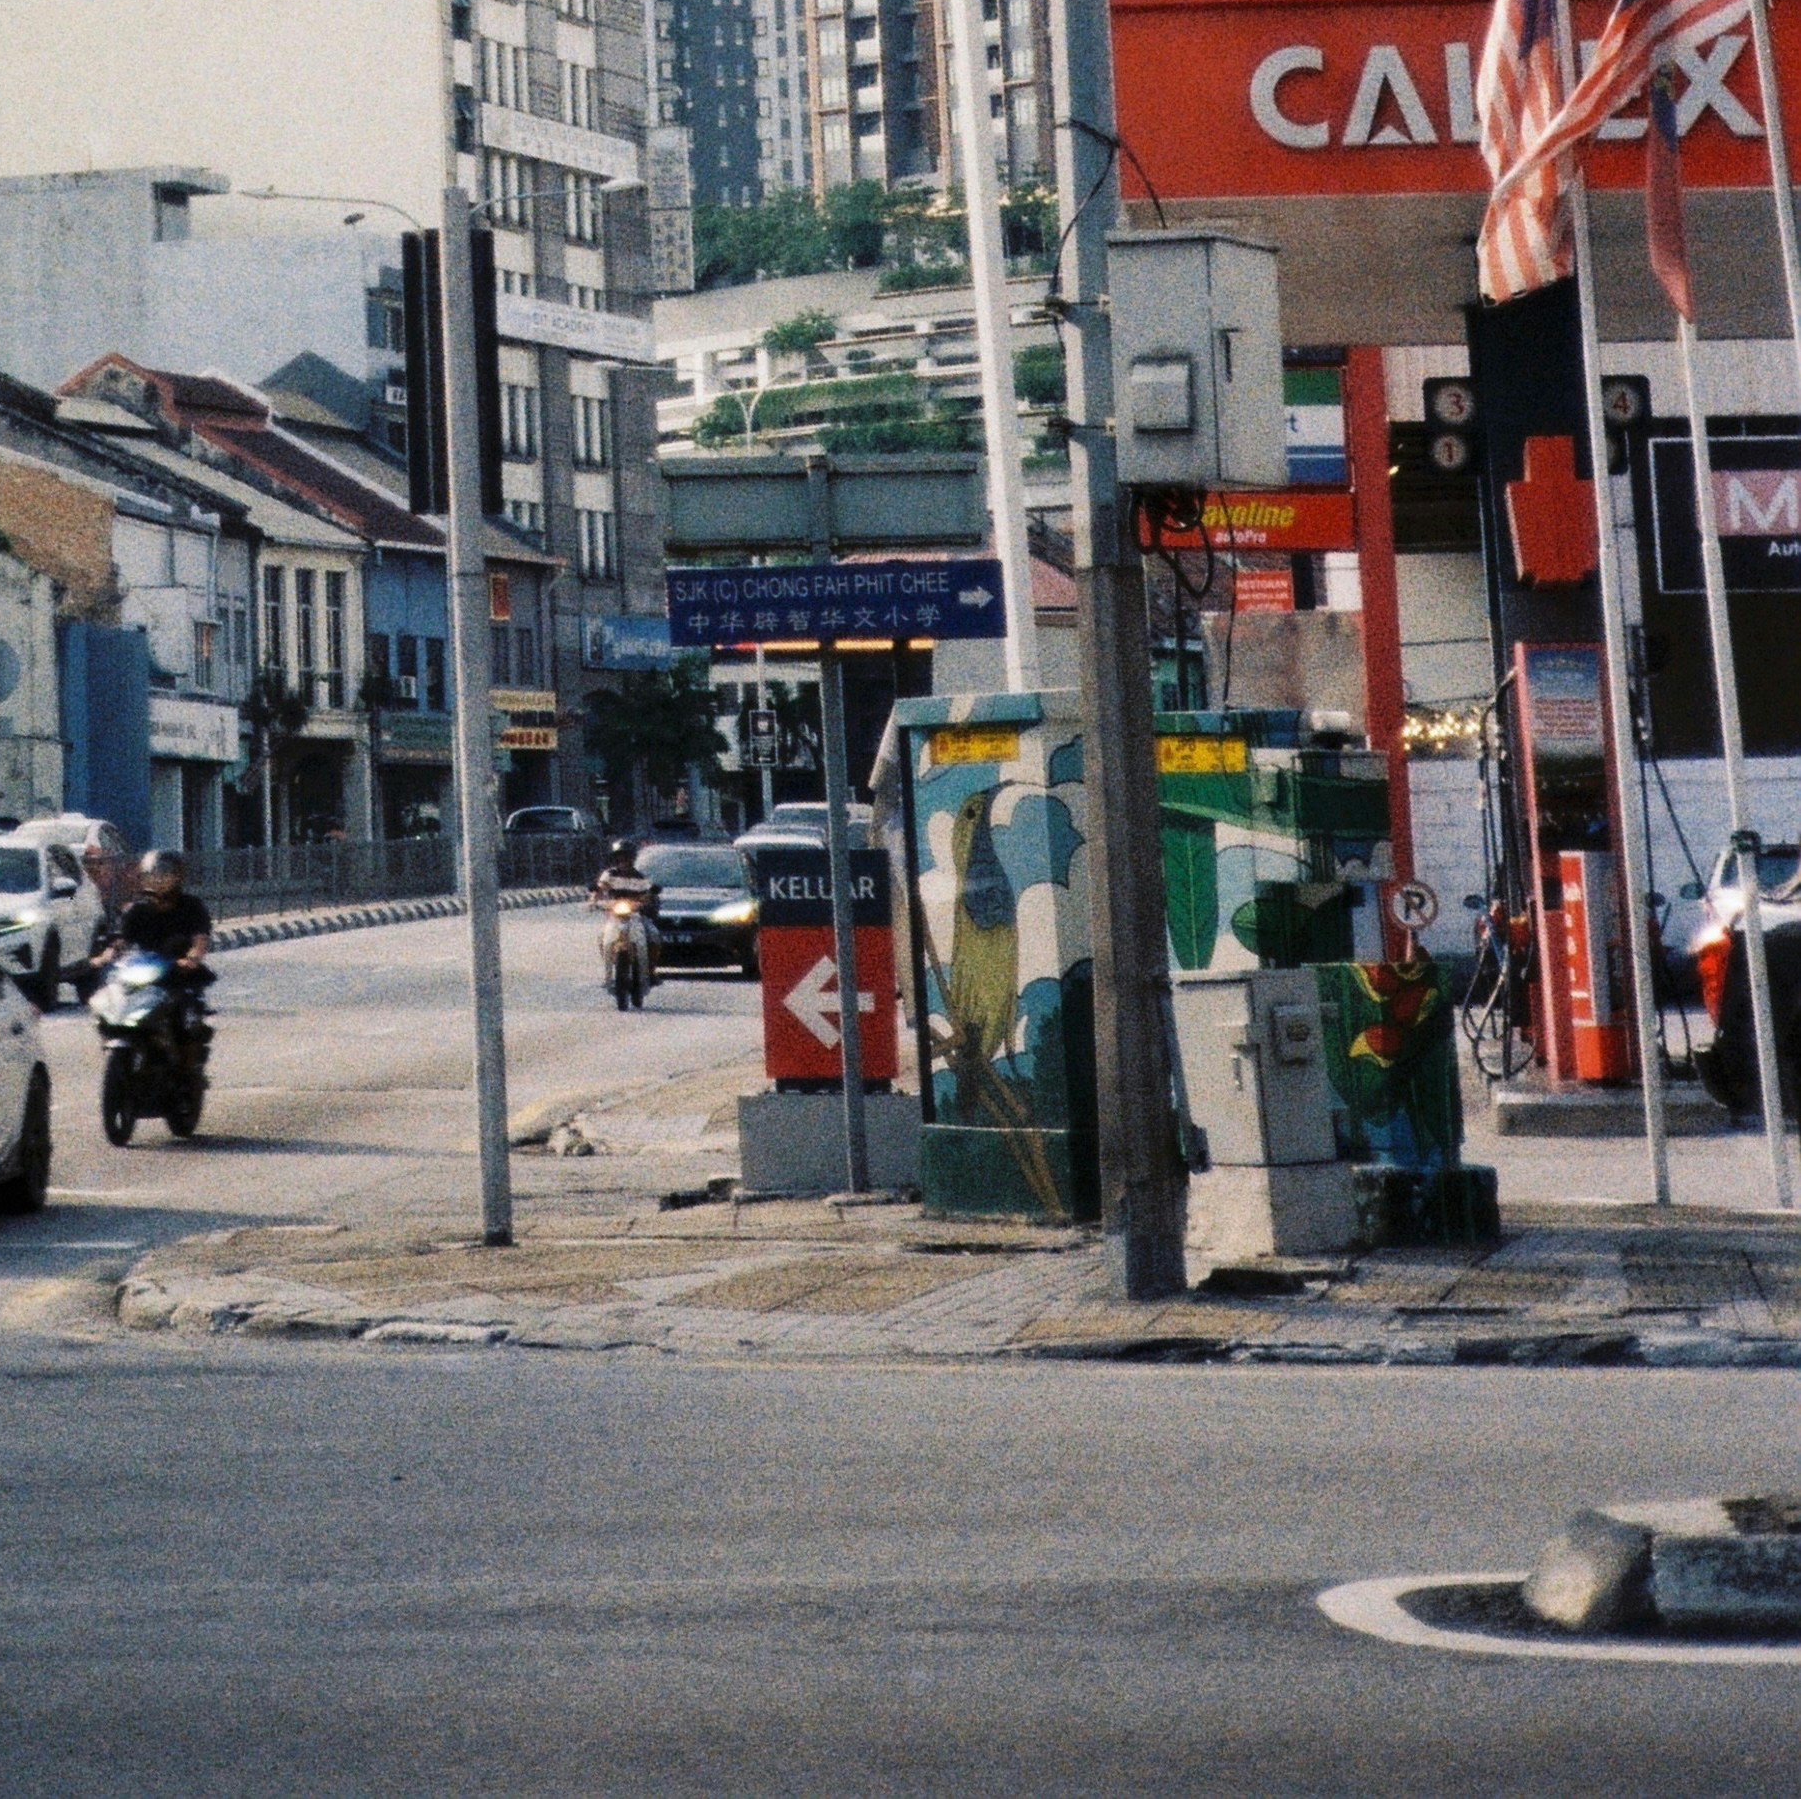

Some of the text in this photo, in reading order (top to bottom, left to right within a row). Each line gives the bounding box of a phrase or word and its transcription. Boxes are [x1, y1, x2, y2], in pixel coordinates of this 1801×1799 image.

[1451, 390, 1631, 417] 3 4
[1444, 441, 1454, 463] 1
[676, 570, 950, 604] SJK (C) CHONG FAH PHIT CHEE
[688, 603, 942, 634] 中华辟智华文小学
